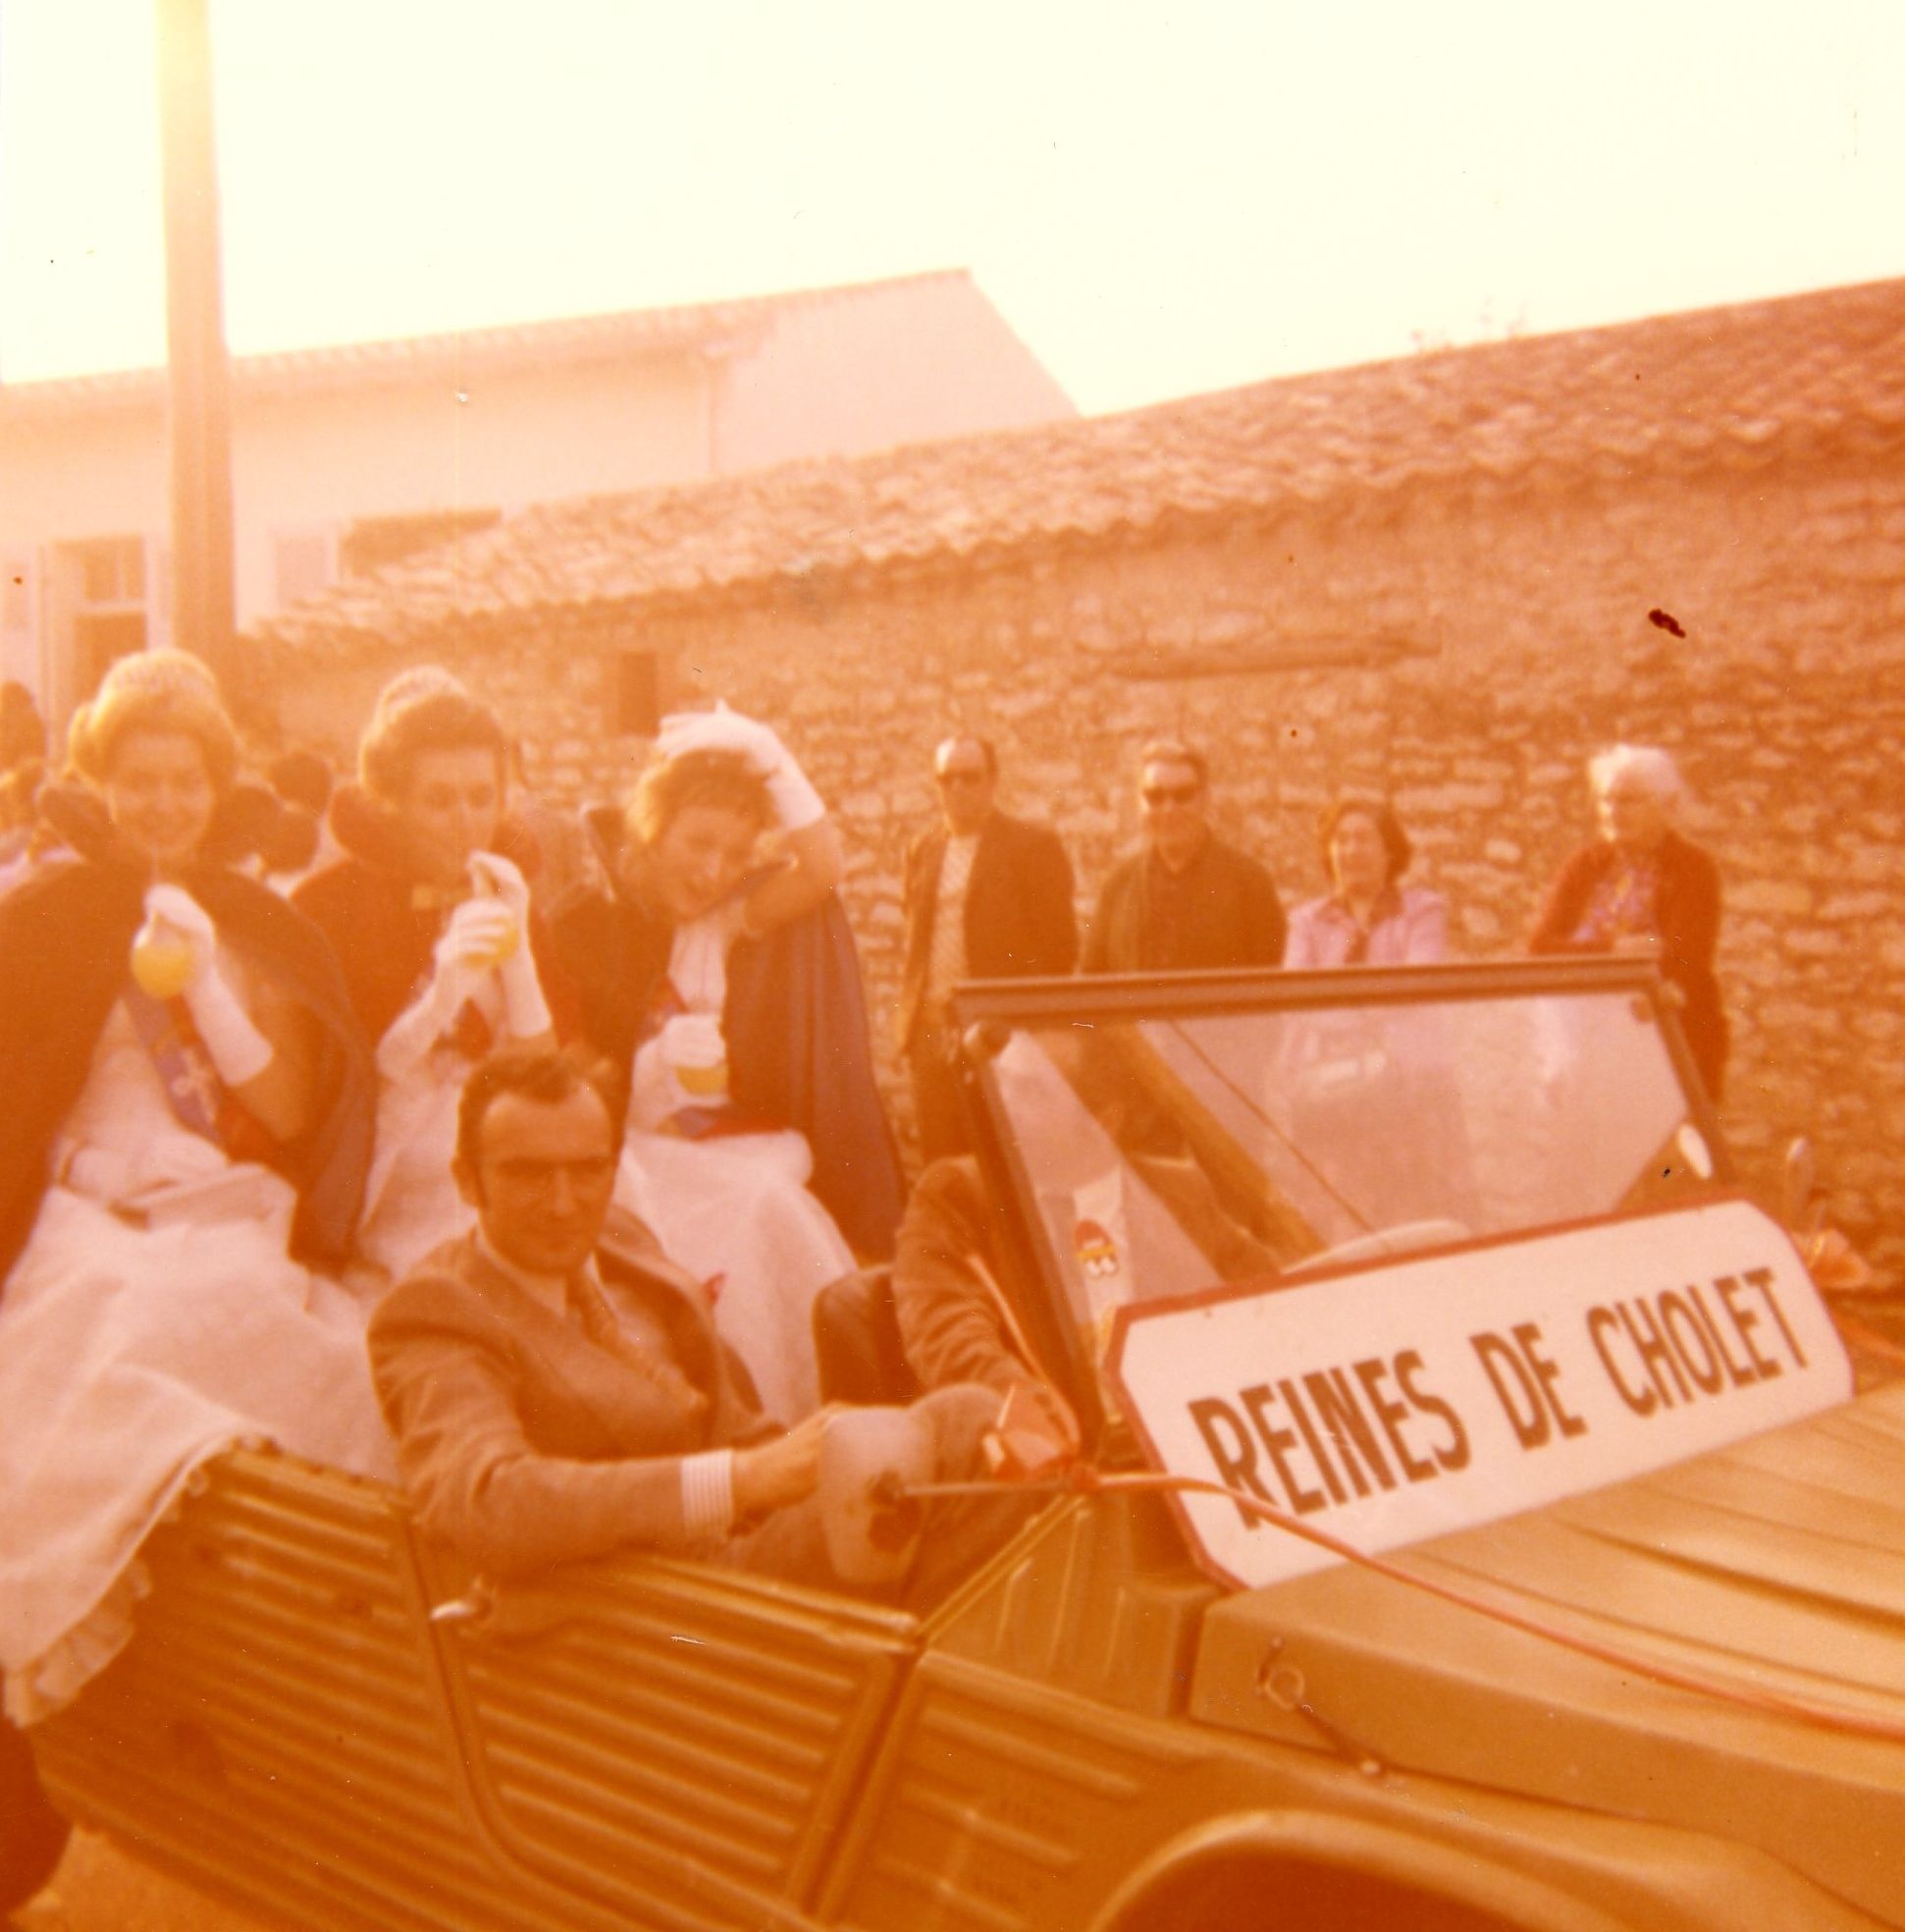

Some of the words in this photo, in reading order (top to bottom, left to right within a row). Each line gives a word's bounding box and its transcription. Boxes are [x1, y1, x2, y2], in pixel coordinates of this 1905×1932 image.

[1188, 1349, 1472, 1531] REINES
[1468, 1322, 1588, 1451] DE
[1586, 1267, 1808, 1418] CHOLET
